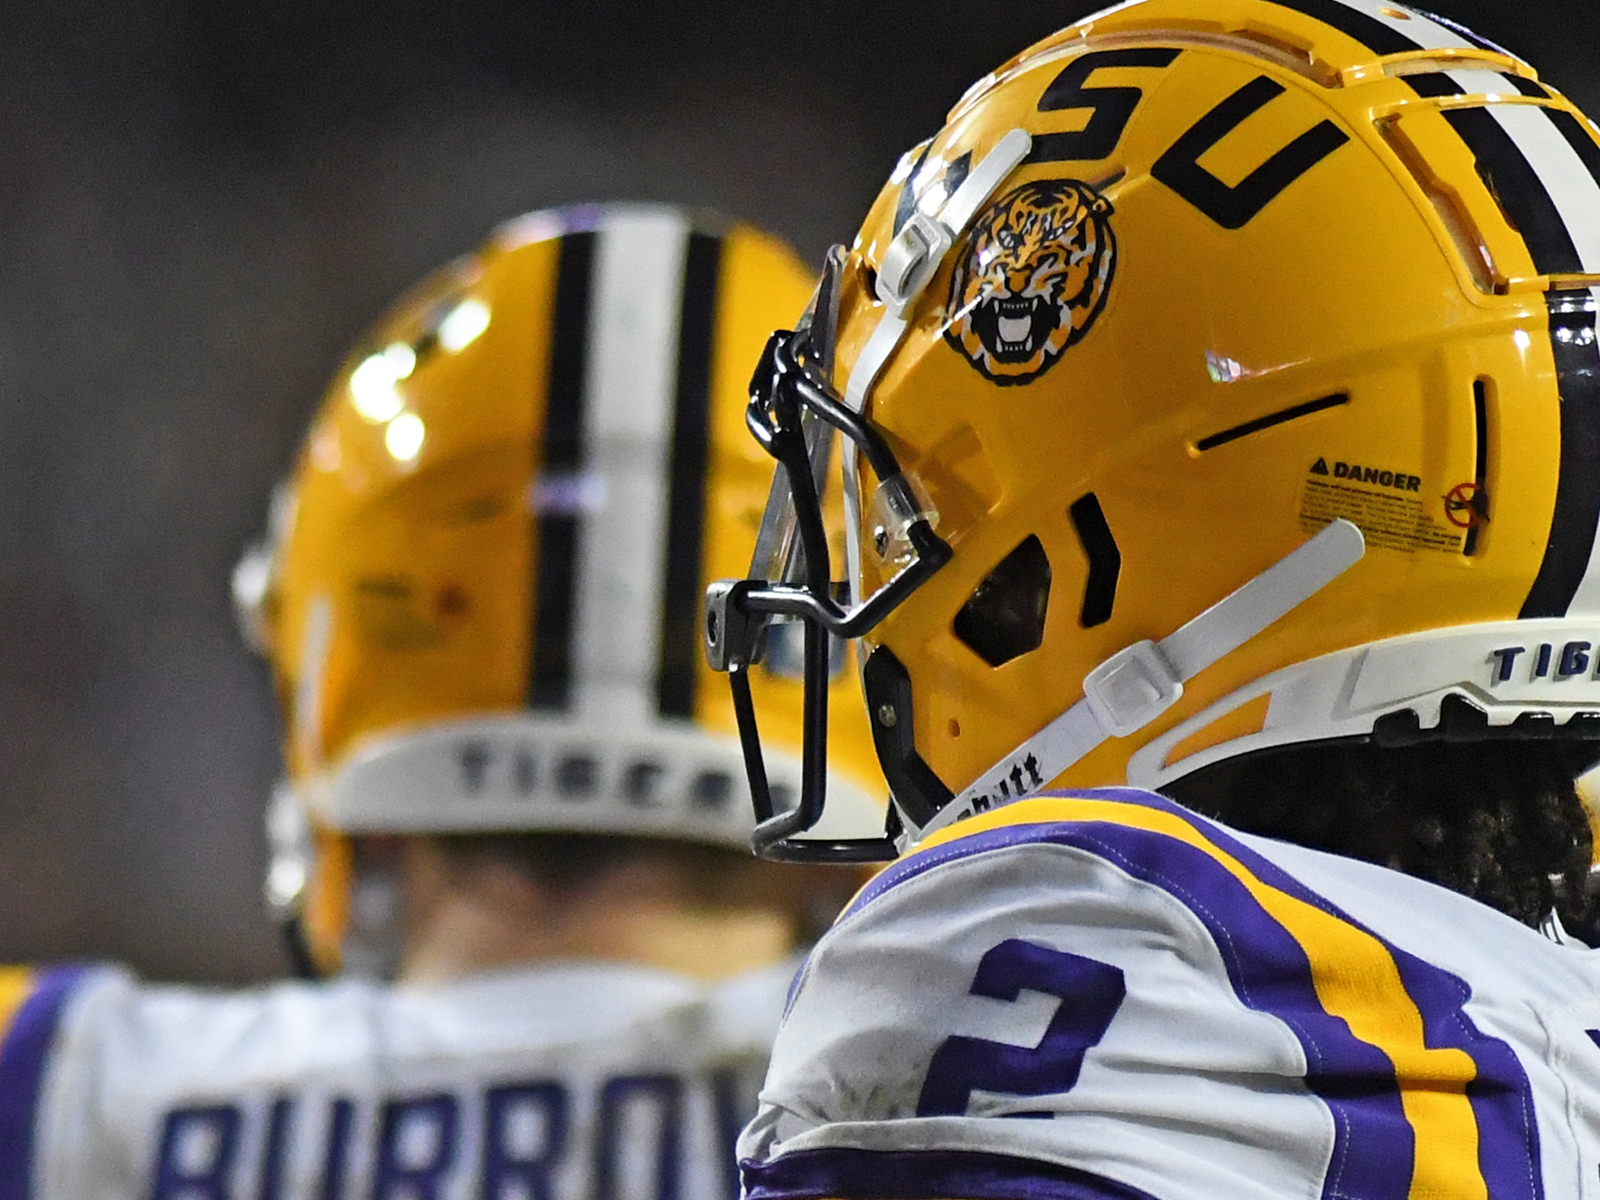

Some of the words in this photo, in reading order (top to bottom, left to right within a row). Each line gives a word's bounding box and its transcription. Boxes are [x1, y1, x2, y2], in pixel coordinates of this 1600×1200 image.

[1333, 461, 1422, 492] DANGER
[1493, 641, 1600, 681] TIG
[916, 938, 1126, 1120] 2
